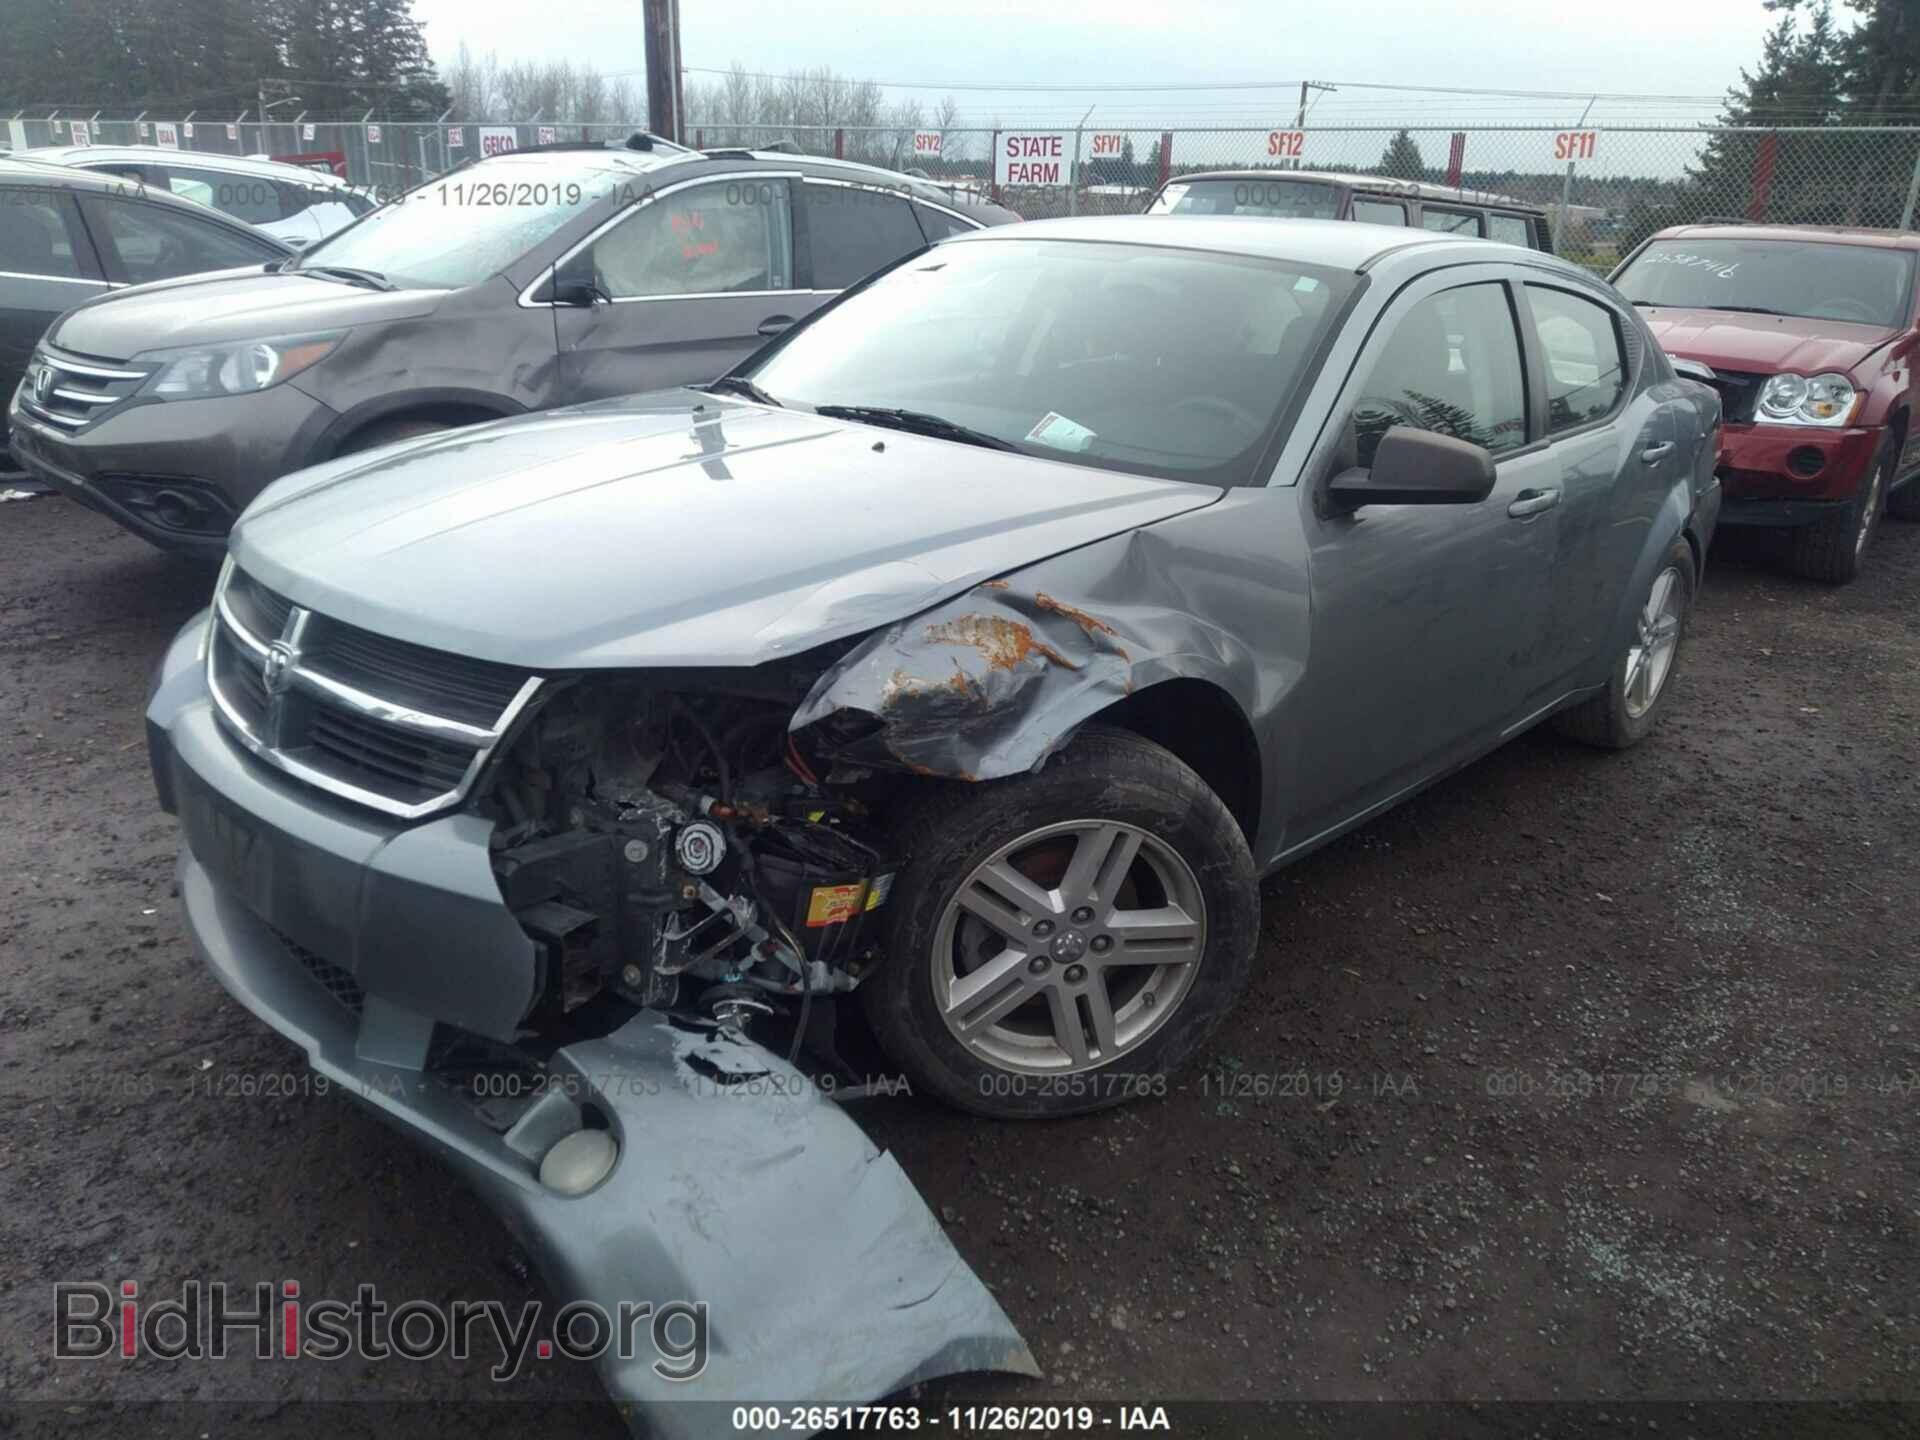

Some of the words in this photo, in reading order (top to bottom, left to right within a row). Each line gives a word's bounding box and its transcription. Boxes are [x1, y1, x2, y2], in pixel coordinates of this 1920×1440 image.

[483, 136, 513, 154] GEICO
[916, 134, 940, 150] SFV2
[1006, 136, 1063, 157] STATE
[1093, 134, 1121, 153] SFV1
[1268, 132, 1304, 156] SF12
[1554, 132, 1596, 159] SF11
[1008, 163, 1059, 183] FARM
